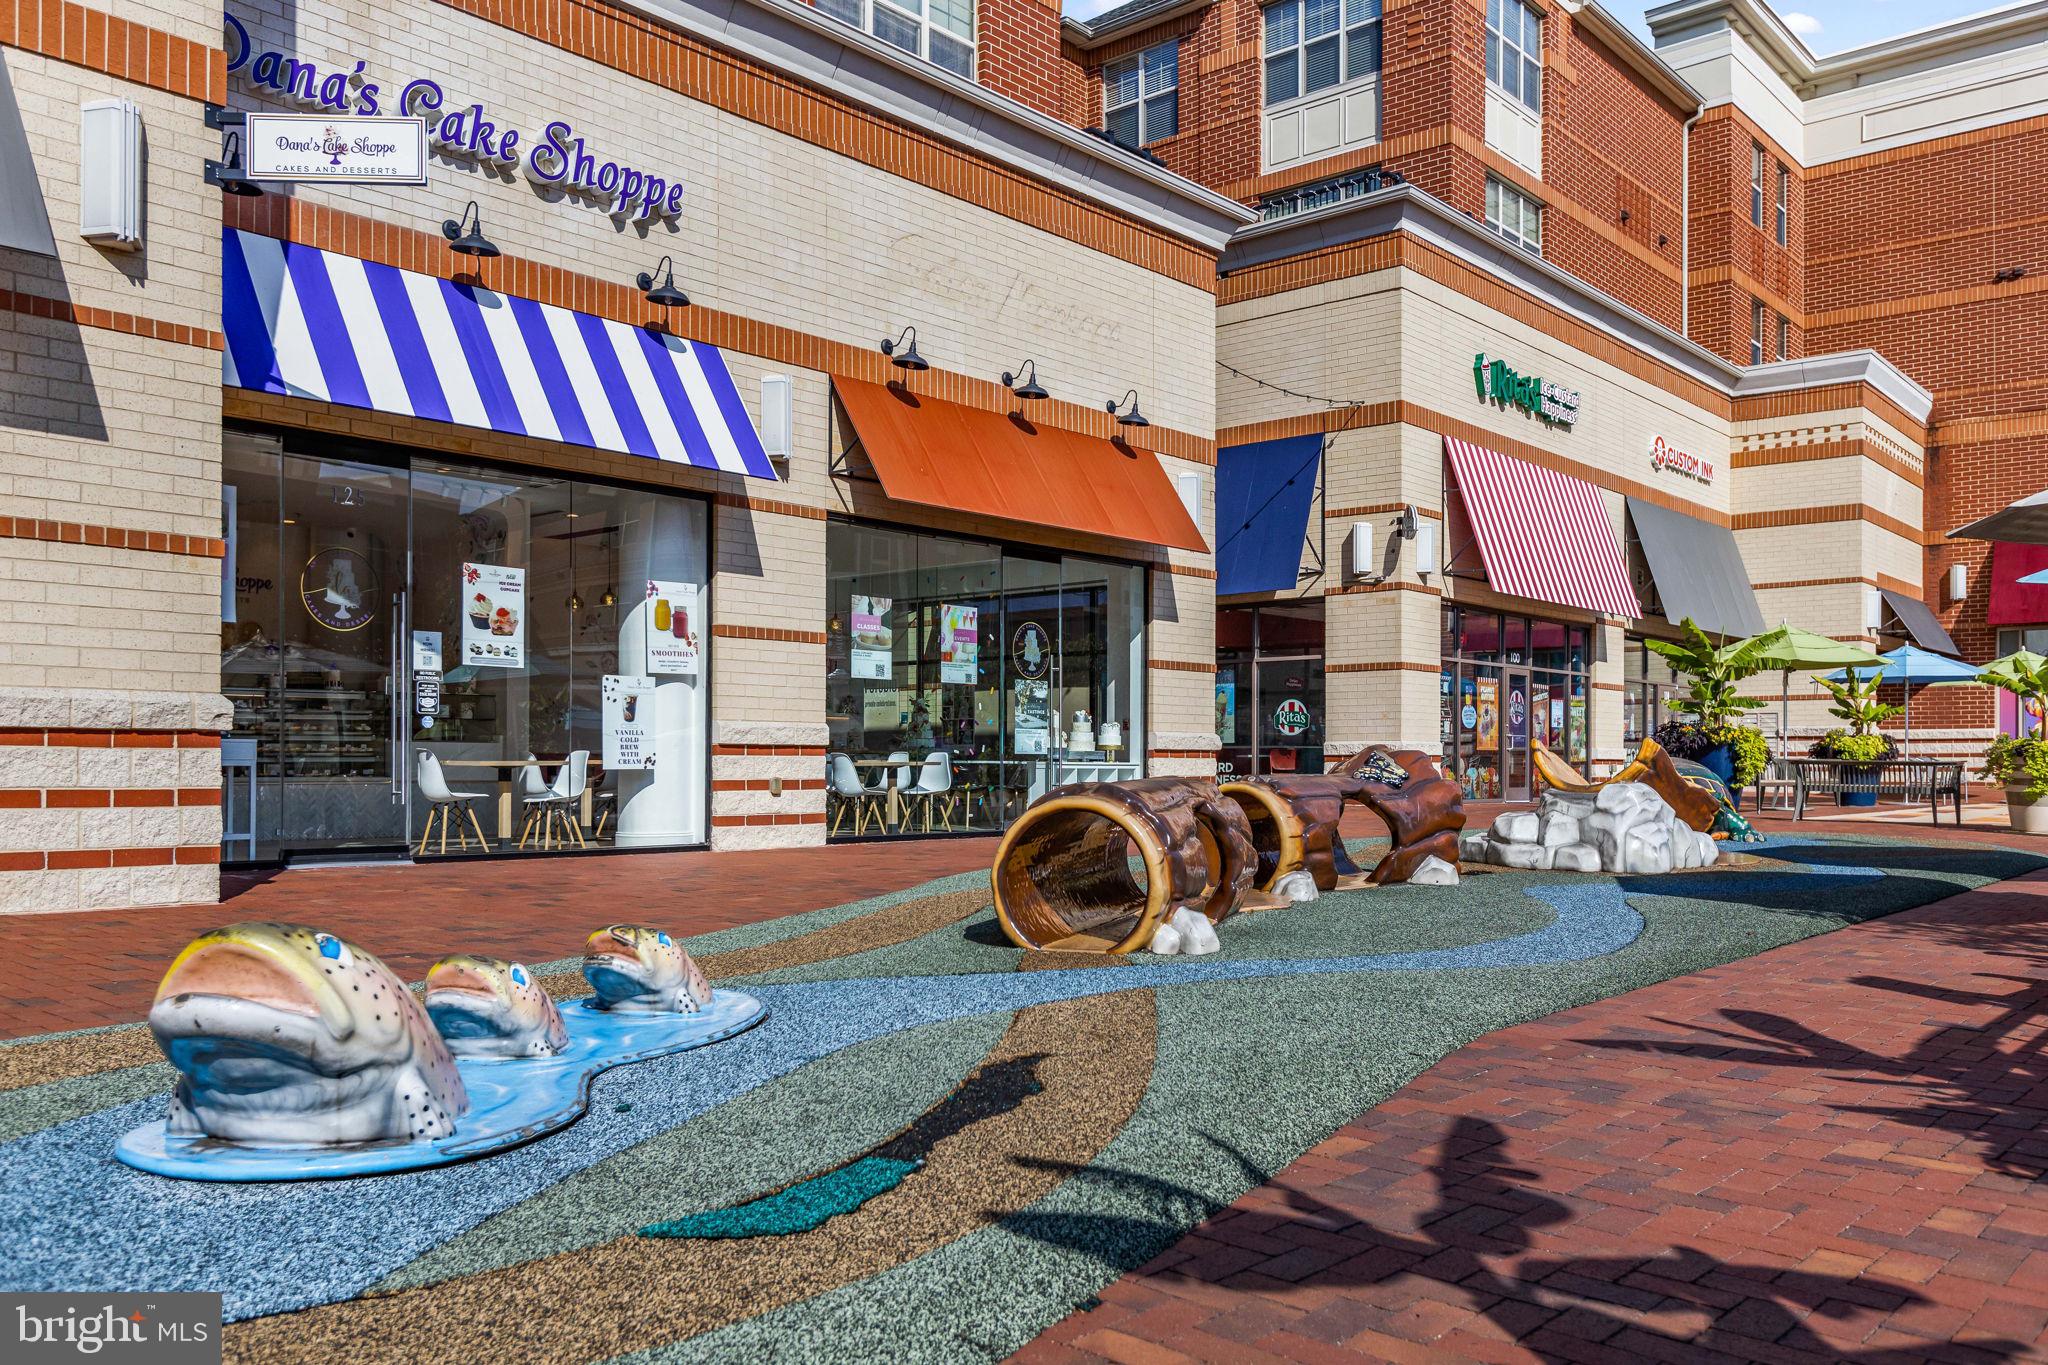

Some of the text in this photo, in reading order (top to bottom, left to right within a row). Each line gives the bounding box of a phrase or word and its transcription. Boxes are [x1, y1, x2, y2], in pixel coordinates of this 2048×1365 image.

[275, 136, 397, 157] Dana's Cake Shoppe
[400, 79, 519, 161] Cake
[529, 121, 684, 219] Shoppe
[275, 164, 398, 175] CAKES AND DESSERTS
[1541, 395, 1579, 424] Happiness
[1667, 447, 1714, 480] CUSTOM INK
[856, 623, 881, 631] CLASSES
[651, 649, 694, 658] SMOOTHIES
[1510, 652, 1520, 664] 100
[1279, 711, 1306, 724] Rita's
